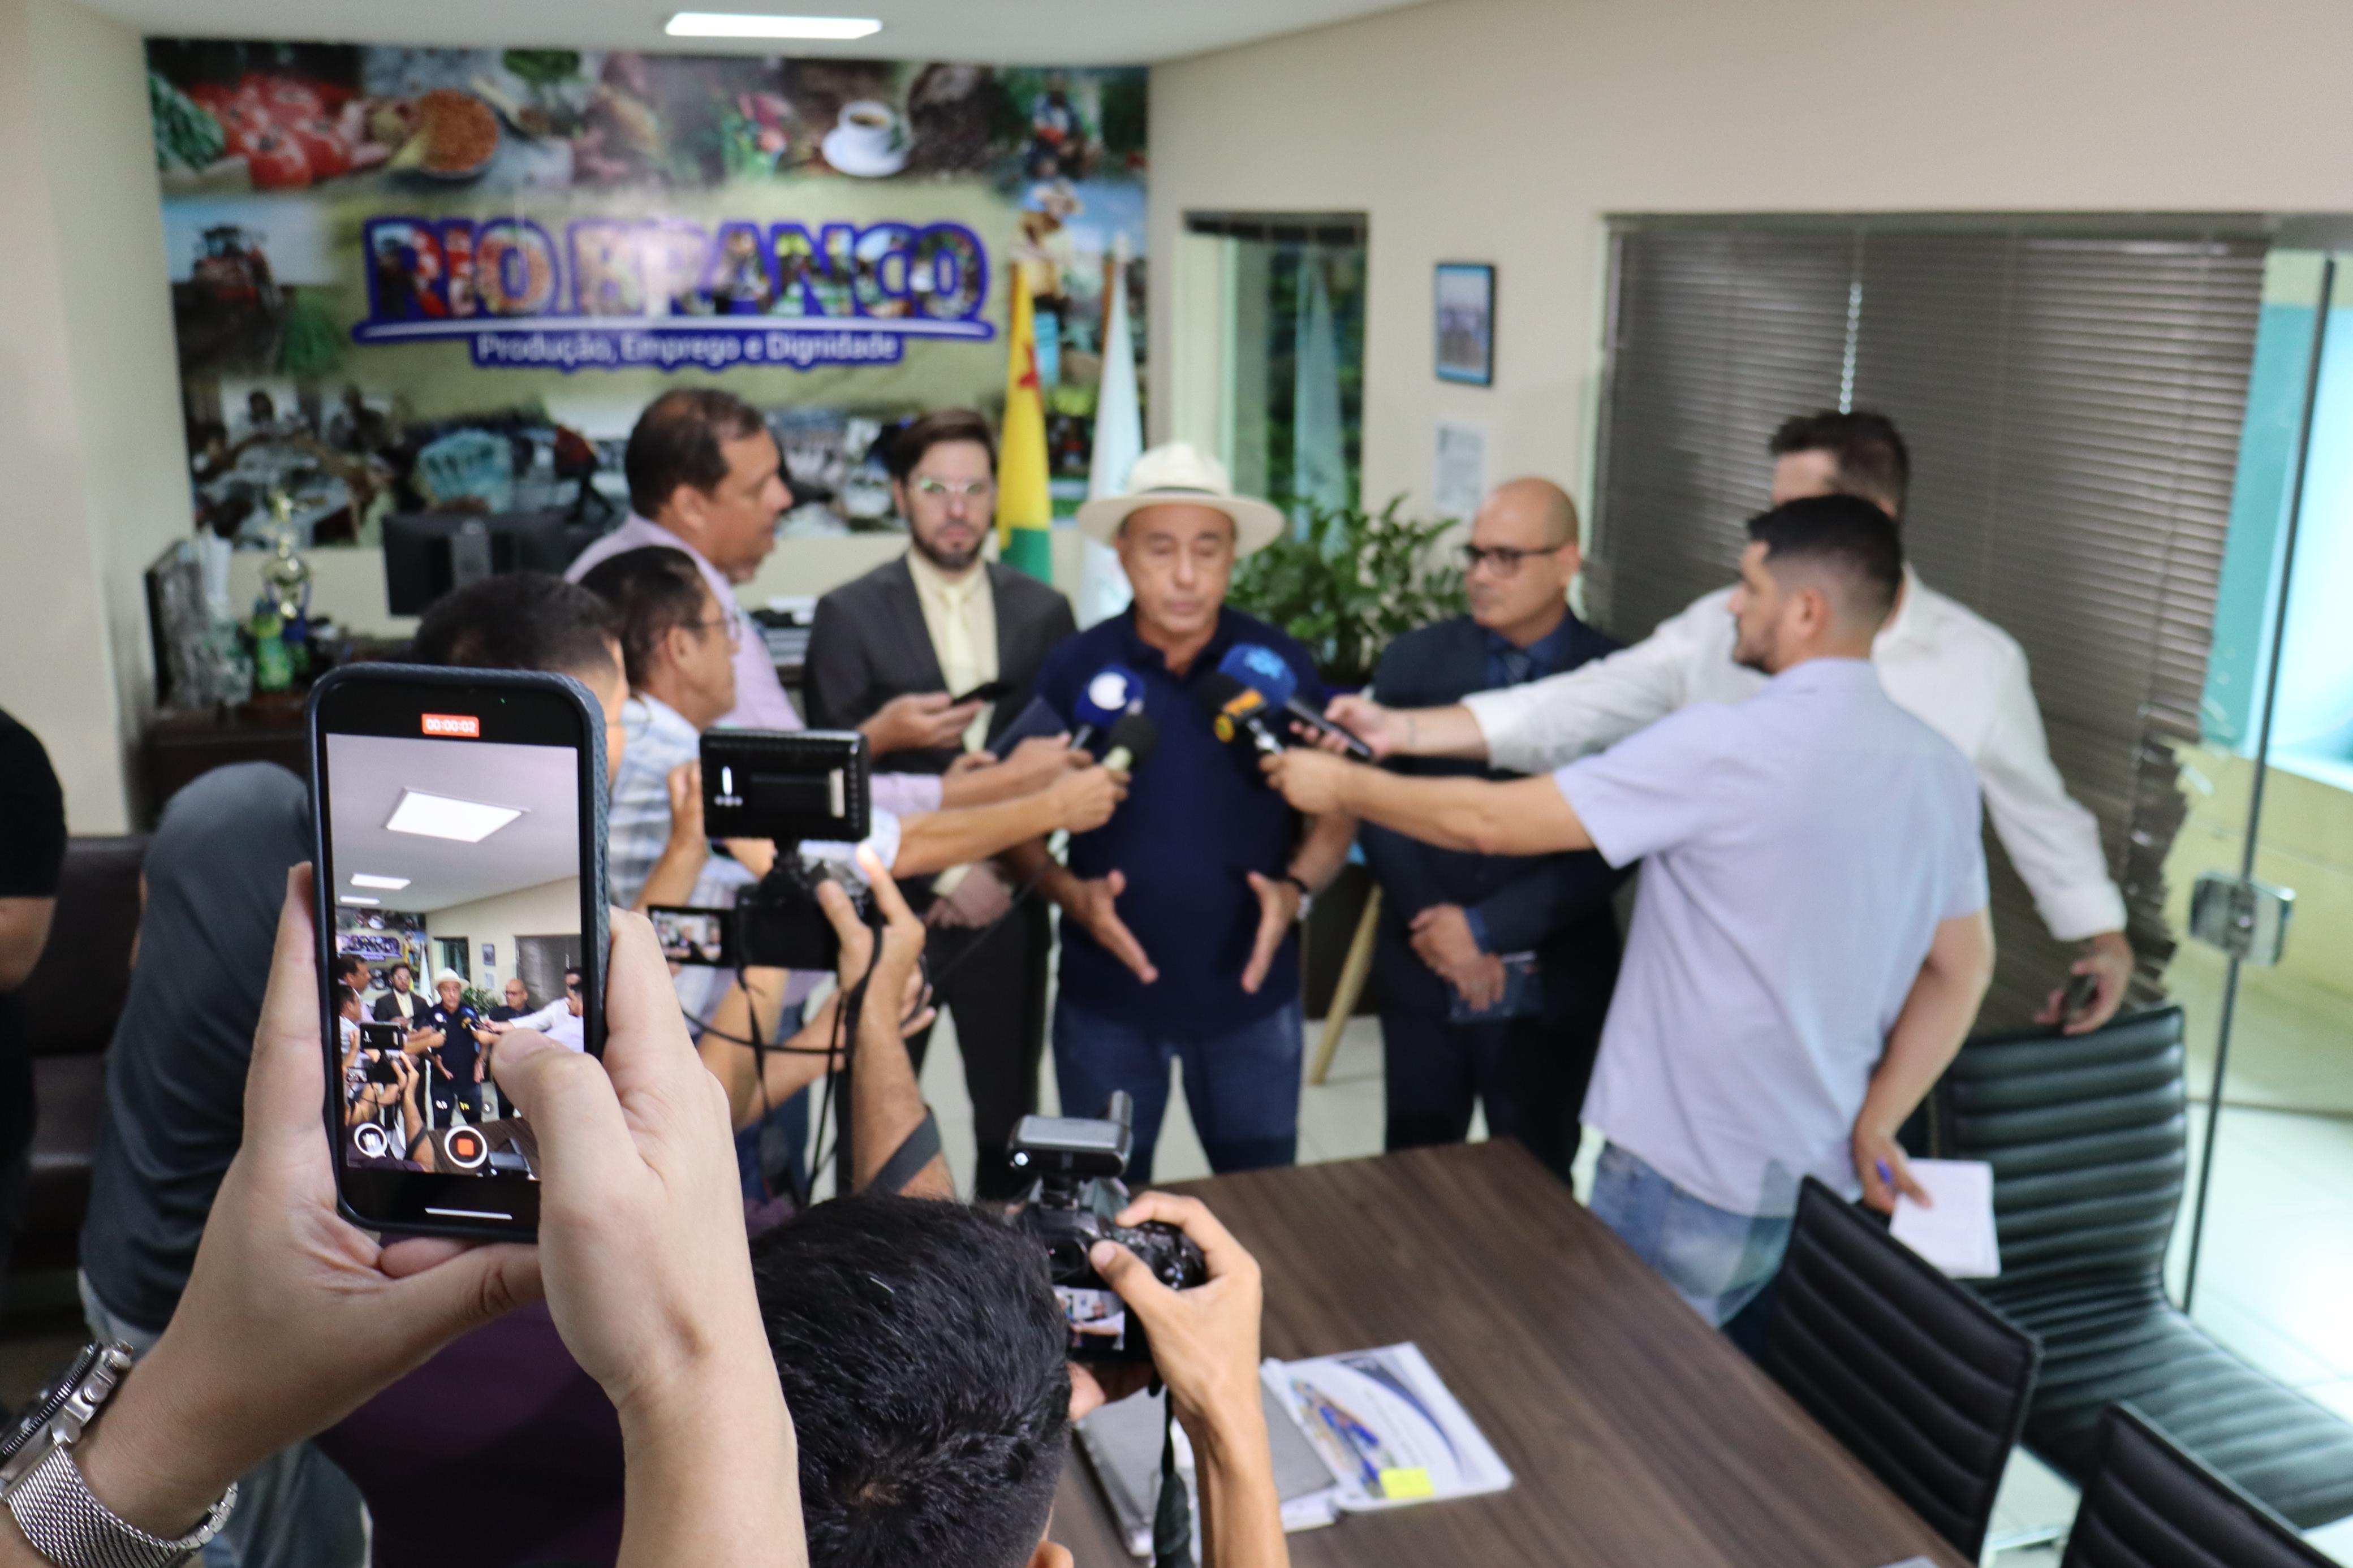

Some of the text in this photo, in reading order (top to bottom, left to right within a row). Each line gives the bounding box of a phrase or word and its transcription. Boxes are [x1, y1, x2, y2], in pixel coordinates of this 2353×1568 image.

[370, 223, 554, 318] RIO
[621, 330, 742, 366] Emprego
[744, 336, 763, 361] e
[766, 331, 897, 366] Dignidade
[425, 718, 476, 733] 00:00:02
